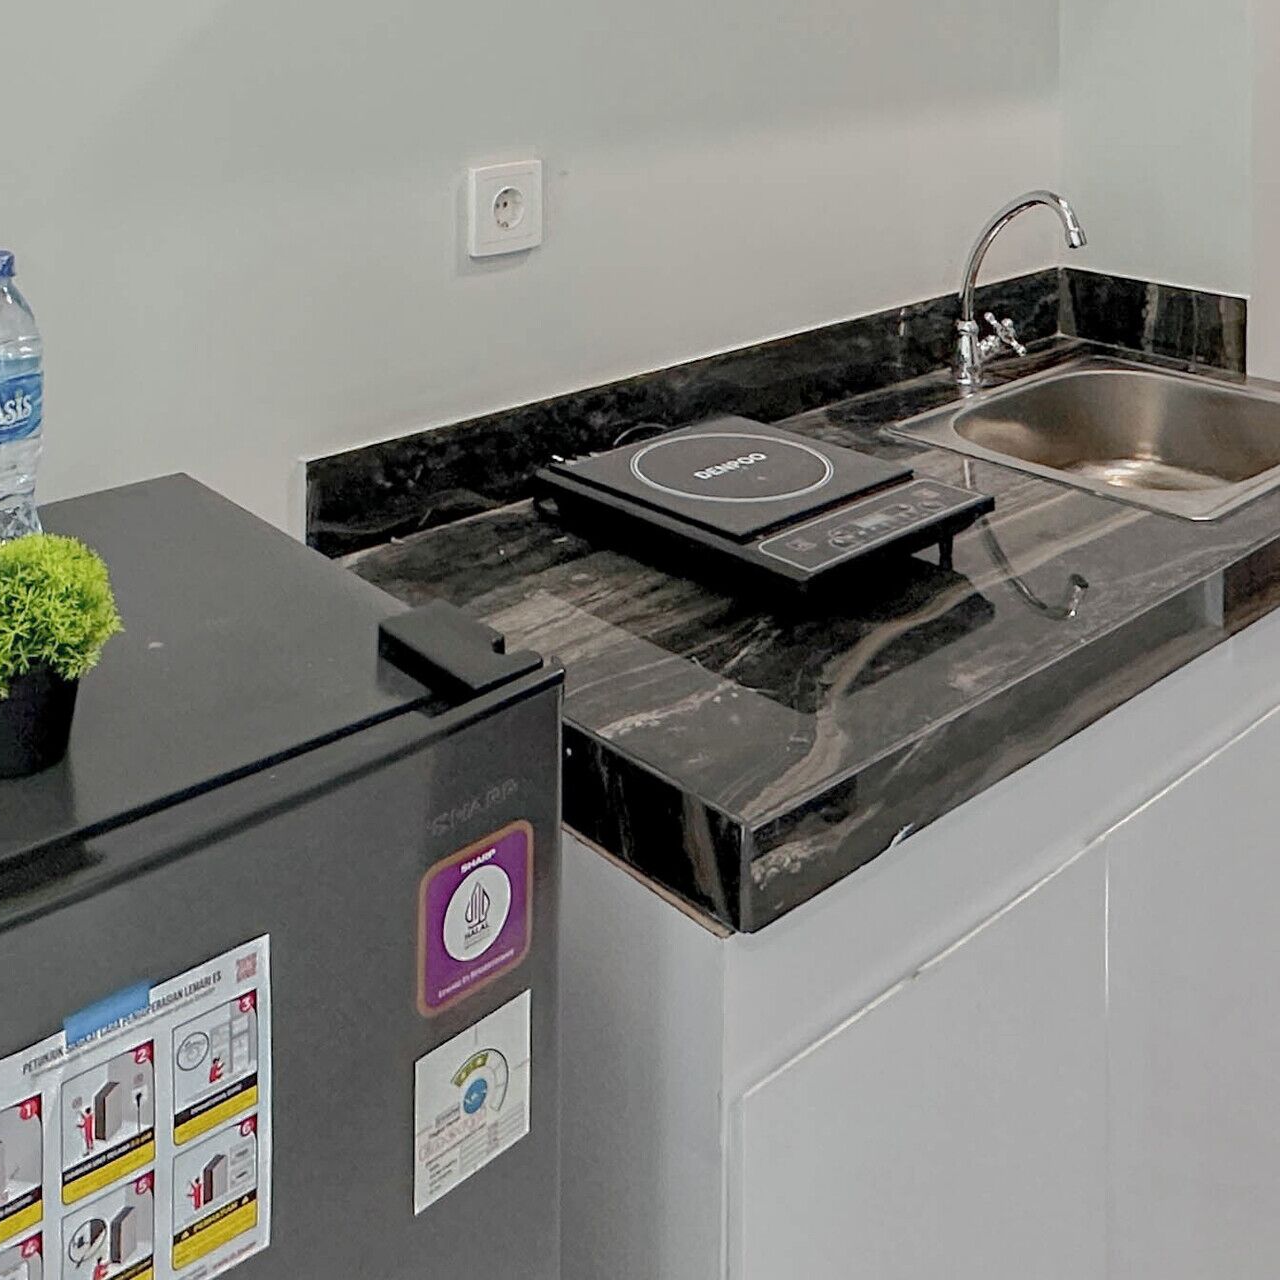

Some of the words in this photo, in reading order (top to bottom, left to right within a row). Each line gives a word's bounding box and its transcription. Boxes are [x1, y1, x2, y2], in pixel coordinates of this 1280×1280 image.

[693, 452, 767, 480] DENPOO
[431, 778, 519, 837] SHARP
[461, 848, 496, 873] SHARP
[464, 921, 489, 939] HALAL
